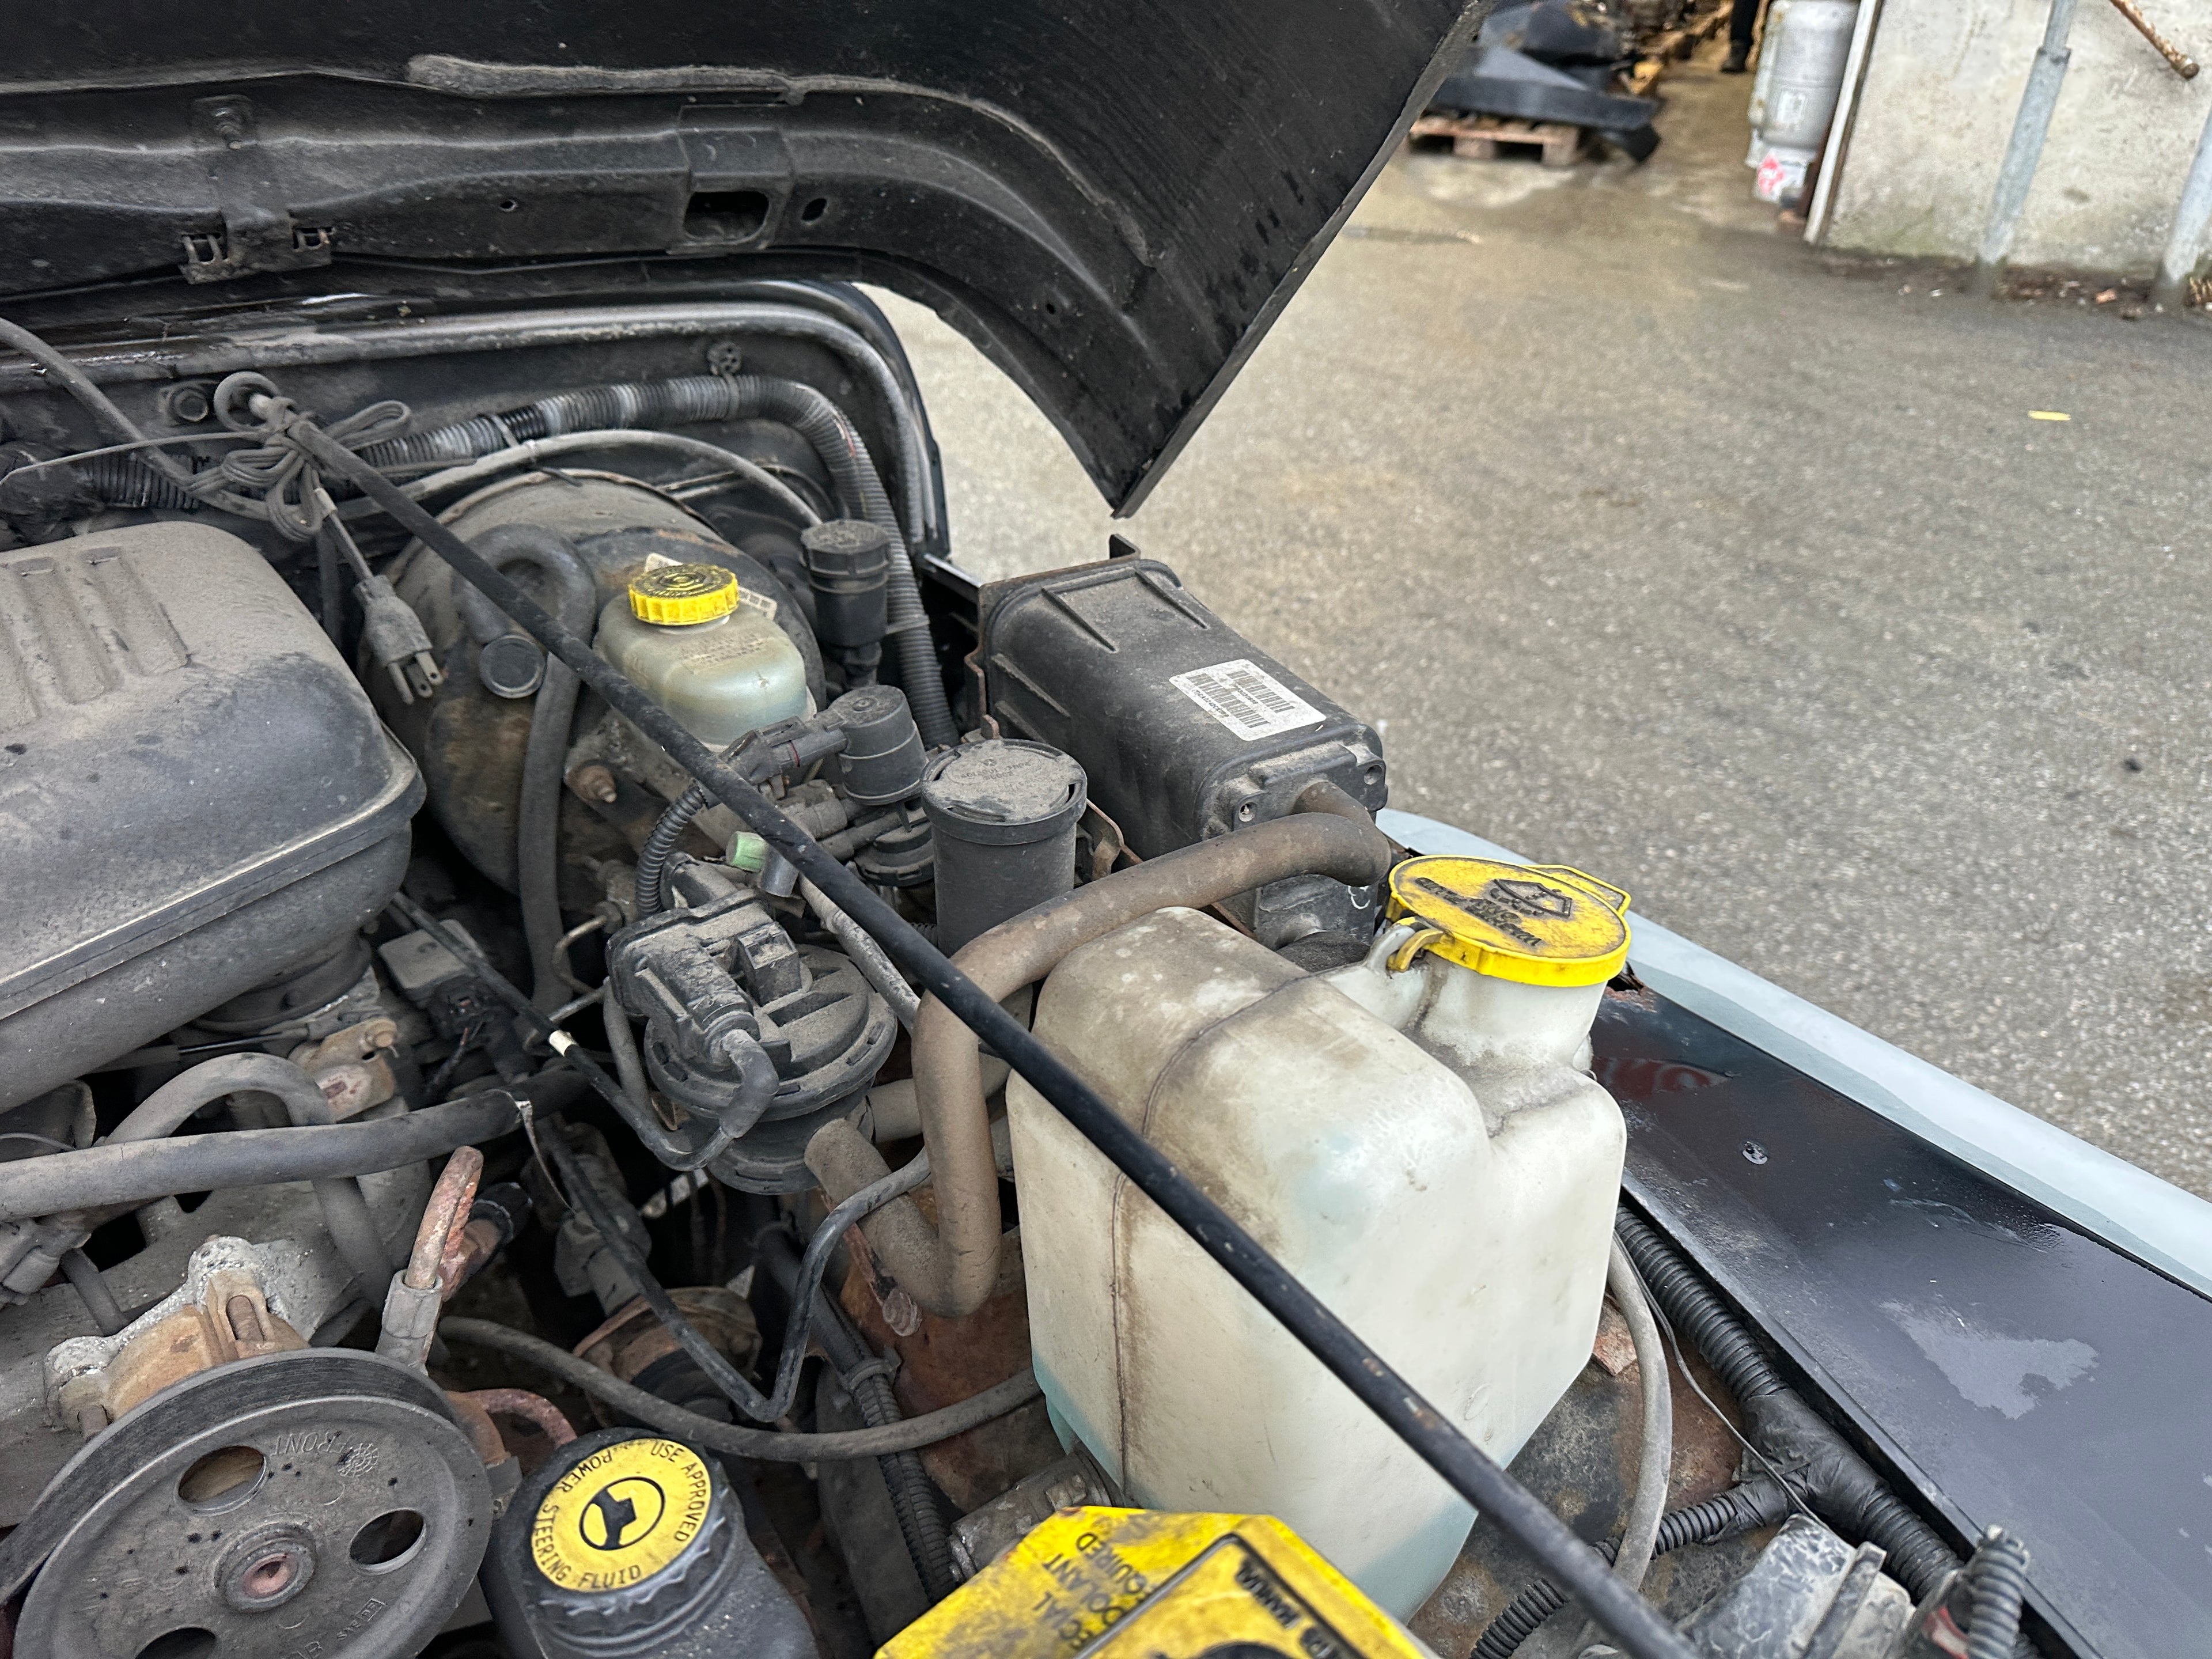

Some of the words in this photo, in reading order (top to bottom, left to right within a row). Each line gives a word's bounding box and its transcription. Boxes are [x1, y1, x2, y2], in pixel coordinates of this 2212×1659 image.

[270, 1431, 352, 1457] FRONT
[650, 1441, 684, 1463] USE
[556, 1449, 613, 1493] POWER
[673, 1462, 707, 1542] APPROVED
[535, 1503, 571, 1582] STEERING
[578, 1564, 641, 1589] FLUID
[1042, 1552, 1124, 1627] OOLANT
[1032, 1591, 1094, 1650] ECIAL
